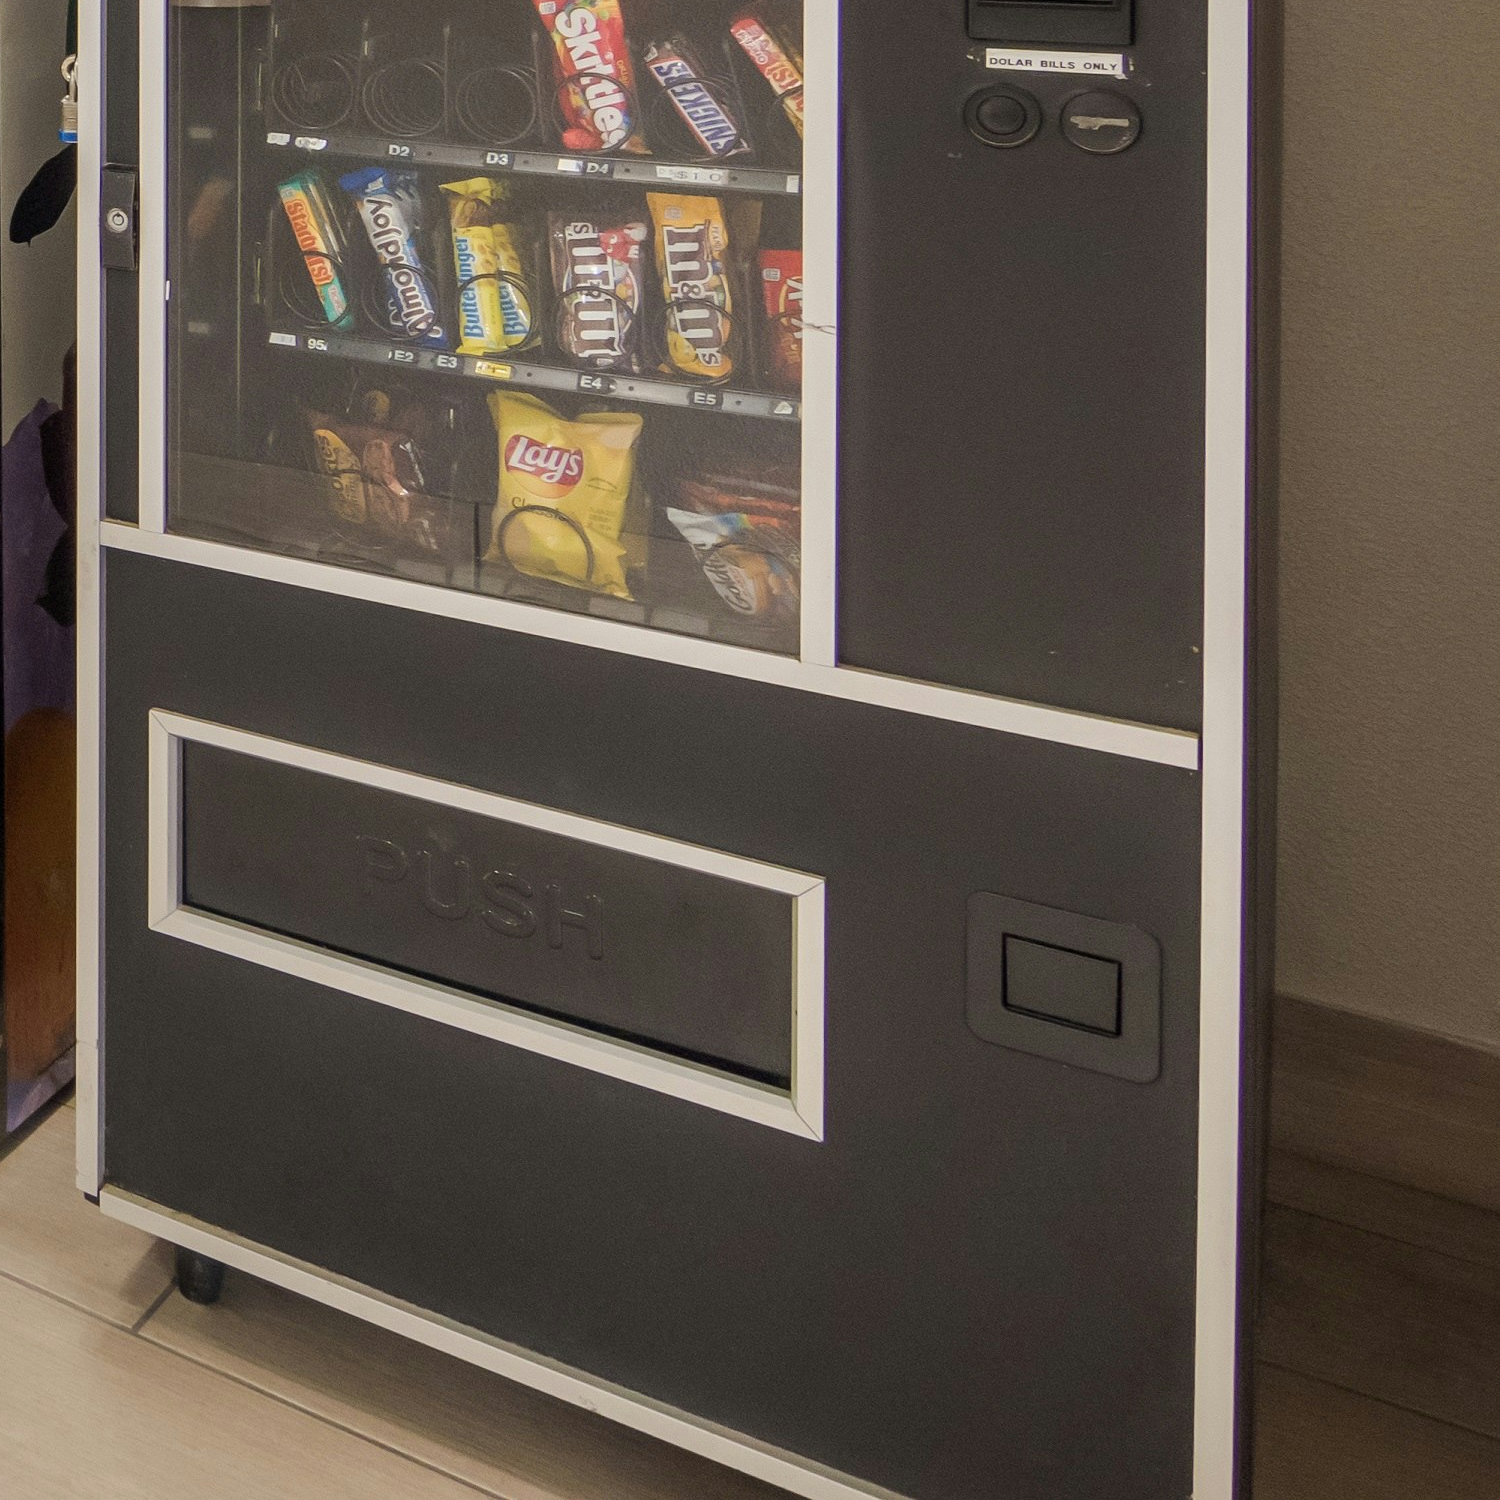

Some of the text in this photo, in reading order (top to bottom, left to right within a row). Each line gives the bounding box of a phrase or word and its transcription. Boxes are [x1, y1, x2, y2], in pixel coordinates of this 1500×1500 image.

[989, 57, 1118, 71] DOLAR BILLS ONLY
[555, 6, 626, 149] Skittles
[654, 61, 736, 155] SNICKERS
[388, 145, 410, 157] D2
[486, 152, 509, 165] D3
[586, 162, 609, 174] D4
[364, 196, 403, 240] Joy
[394, 350, 414, 362] E2
[437, 355, 458, 368] E3
[580, 375, 602, 389] E4
[694, 392, 716, 405] E5
[355, 834, 604, 962] PUSH
